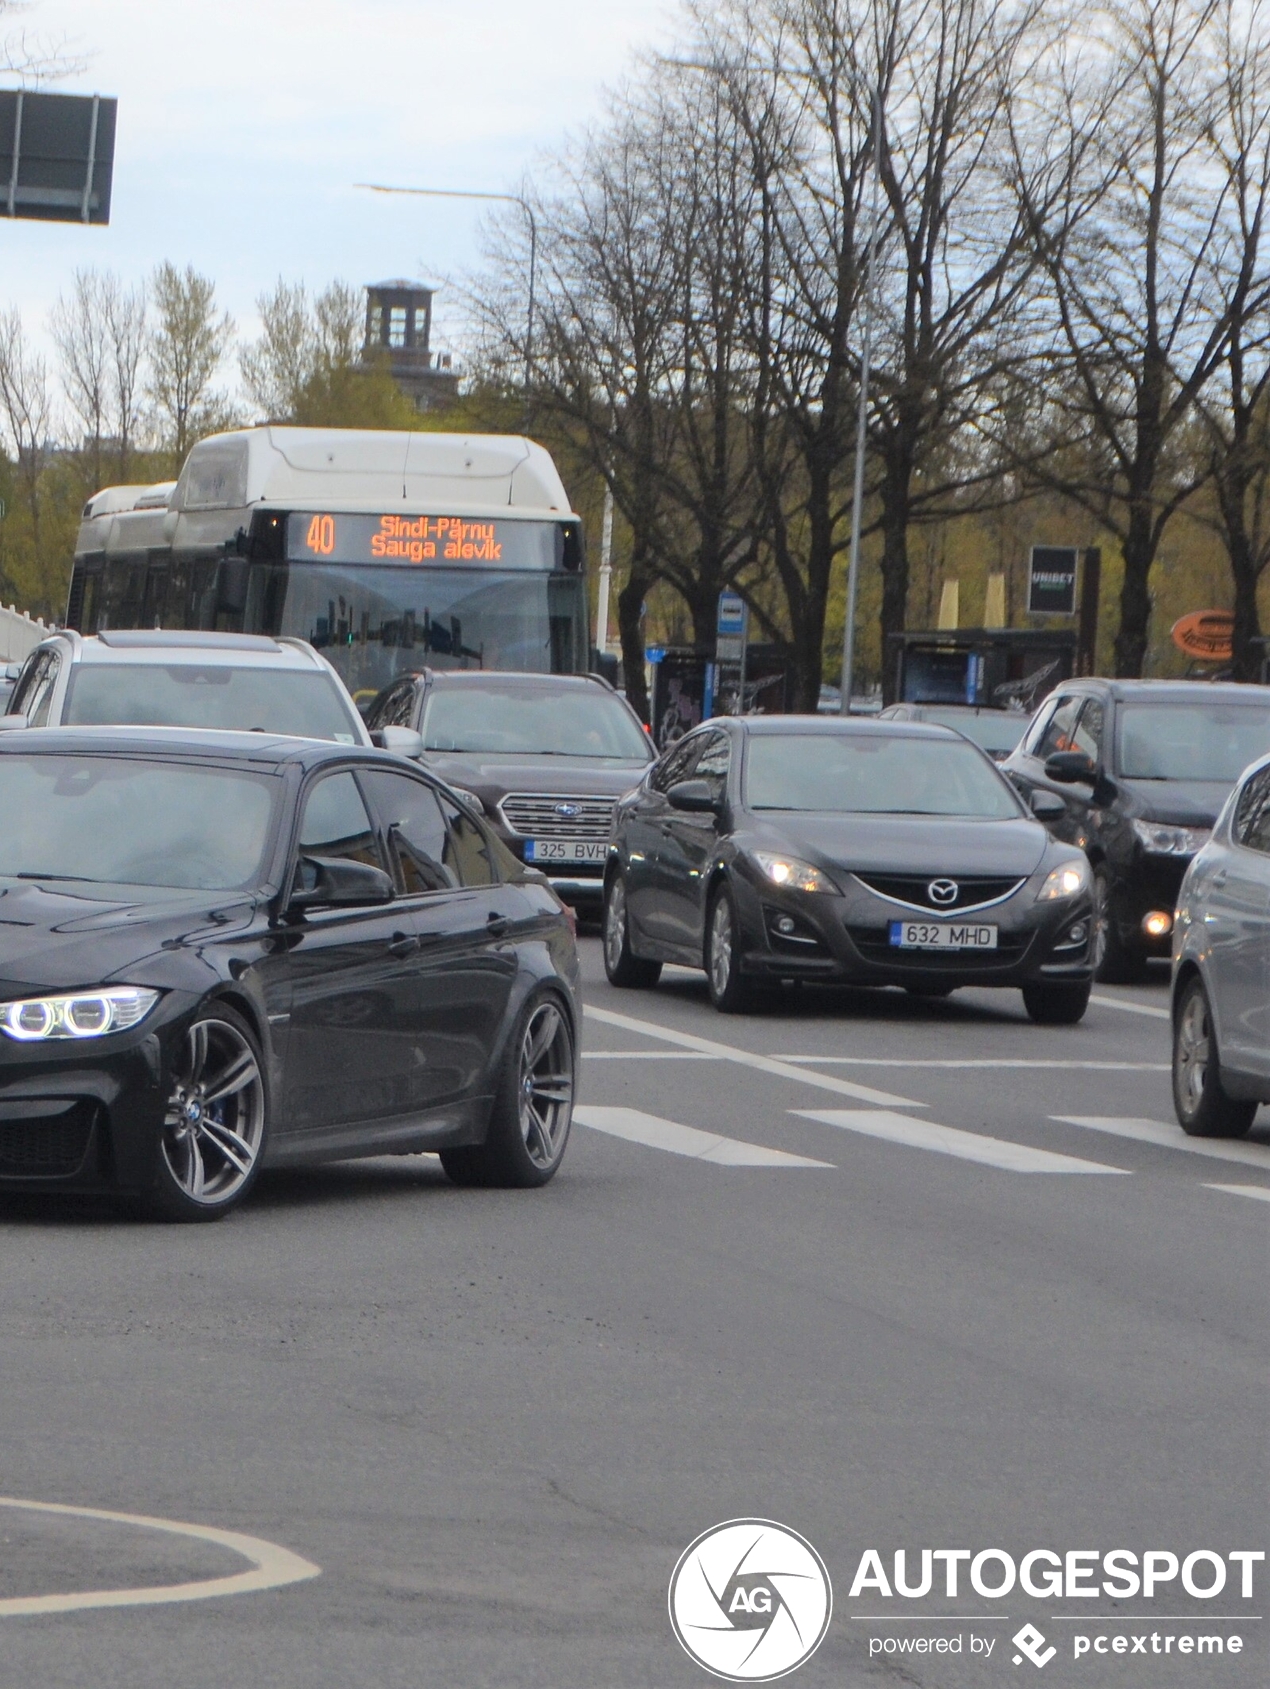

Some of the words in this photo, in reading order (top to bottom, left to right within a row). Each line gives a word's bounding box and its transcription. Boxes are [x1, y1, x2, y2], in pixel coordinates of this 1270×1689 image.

[306, 515, 334, 555] 40
[380, 515, 495, 540] Sindi-Pärnu
[371, 534, 436, 563] Sauga
[443, 538, 502, 560] alevik
[1032, 571, 1074, 585] UNIBET
[540, 842, 566, 858] 325
[574, 844, 607, 859] BVH
[907, 925, 940, 944] 632
[949, 926, 991, 945] MHD
